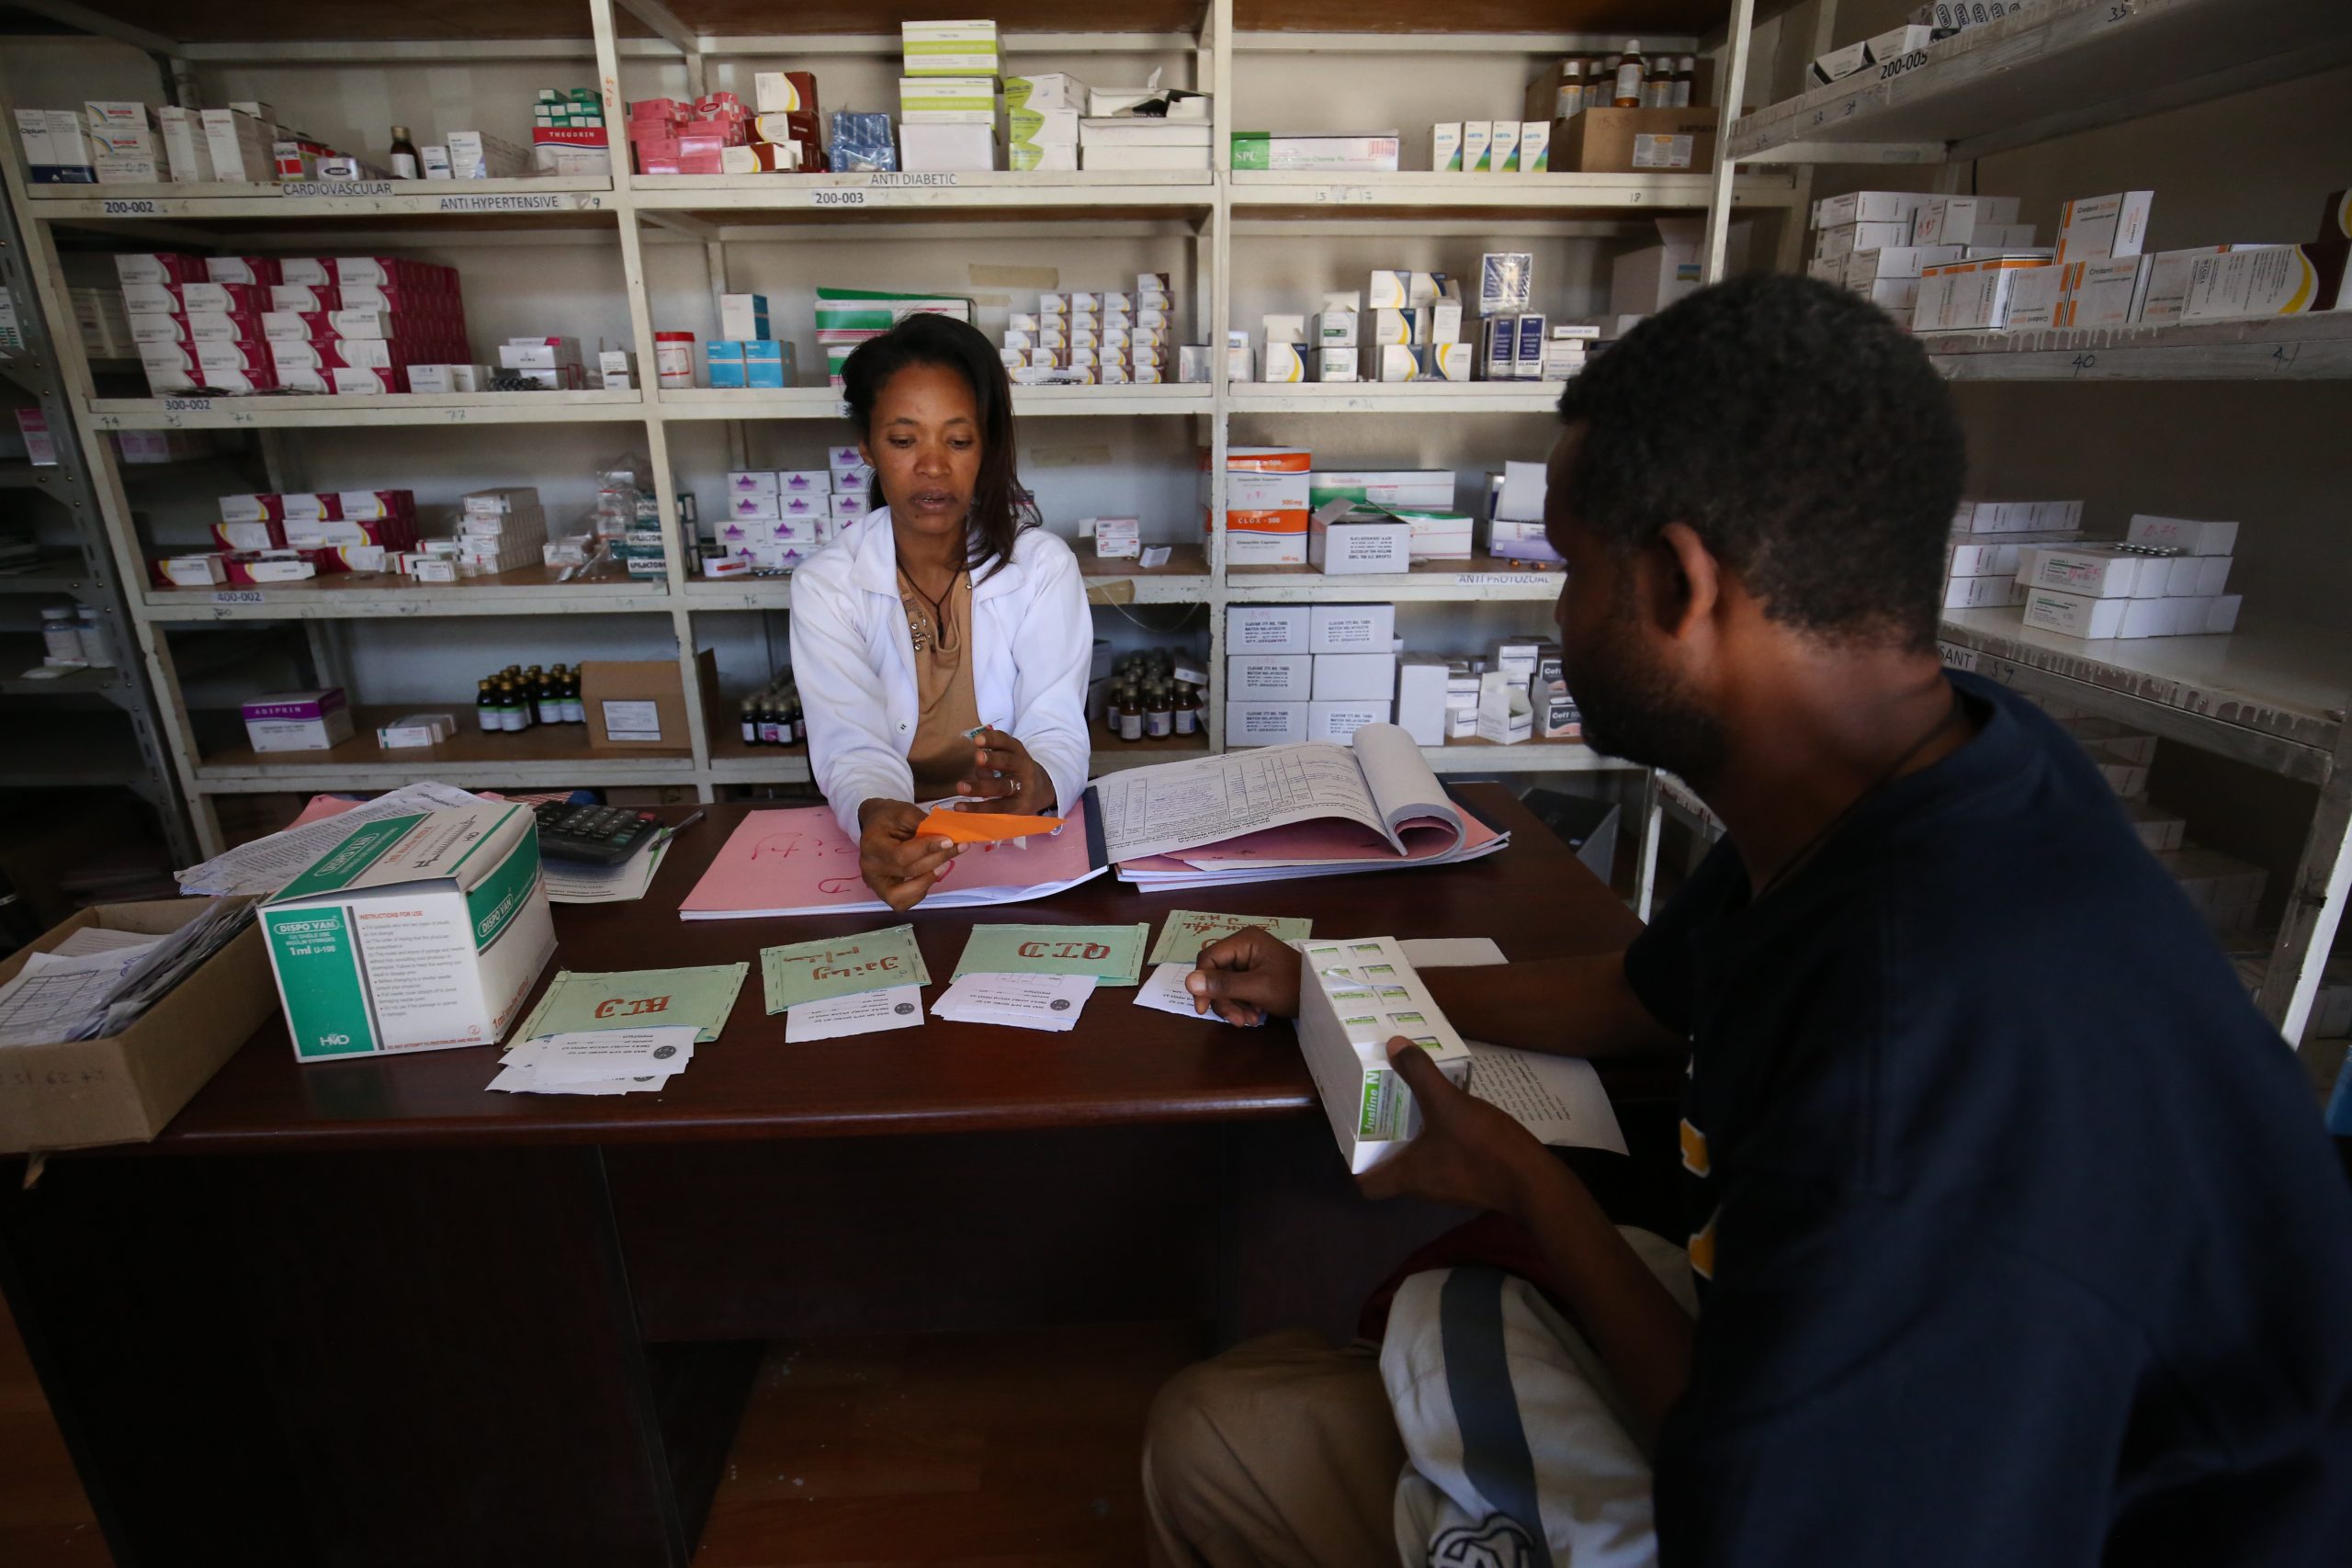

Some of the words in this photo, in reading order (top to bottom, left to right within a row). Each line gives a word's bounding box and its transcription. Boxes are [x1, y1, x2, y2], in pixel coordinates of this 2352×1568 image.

[1881, 51, 1928, 80] 200-005
[1235, 152, 1258, 162] SPC
[871, 174, 898, 186] ANTI
[902, 174, 957, 186] DIABETIC
[283, 183, 393, 196] CARDIOVASCULAR
[440, 198, 469, 210] ANTI
[472, 196, 560, 209] HYPERTENSIVE
[815, 192, 865, 204] 200-003
[105, 201, 154, 213] 200-002
[2072, 354, 2096, 378] 40
[165, 400, 211, 411] 300-002
[1459, 574, 1484, 583] ANTI
[217, 591, 262, 603] 400-002
[359, 911, 399, 919] INSTRUCTIONS
[481, 908, 501, 932] DISPO
[499, 897, 513, 914] VAN
[279, 923, 308, 933] DISPO
[311, 921, 335, 931] VAN
[289, 945, 311, 956] 1ml
[314, 945, 335, 954] U-100
[320, 1033, 350, 1047] HMD
[1366, 1072, 1380, 1085] N
